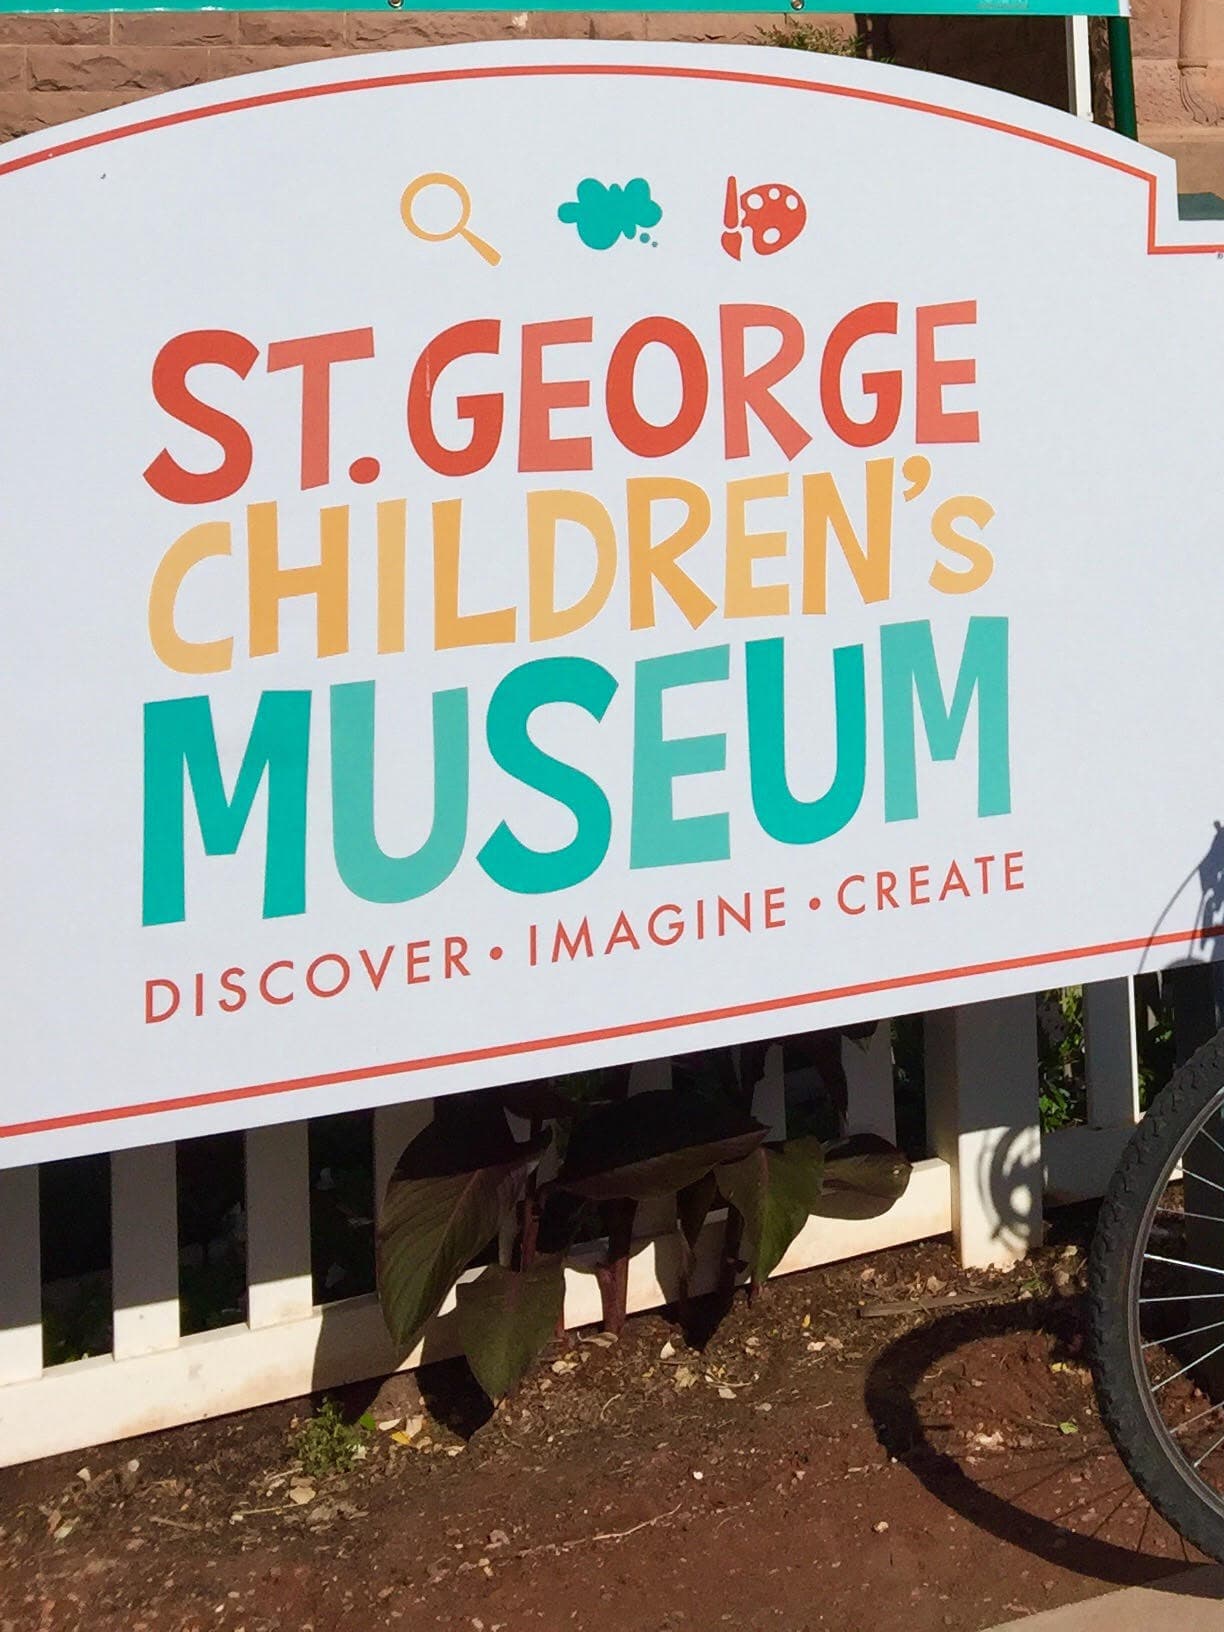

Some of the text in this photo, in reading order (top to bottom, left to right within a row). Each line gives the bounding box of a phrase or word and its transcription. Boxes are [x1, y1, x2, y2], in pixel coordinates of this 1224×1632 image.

[142, 616, 1011, 928] MUSEUM
[144, 850, 1027, 1025] DISCOVER IMAGINE CREATE
